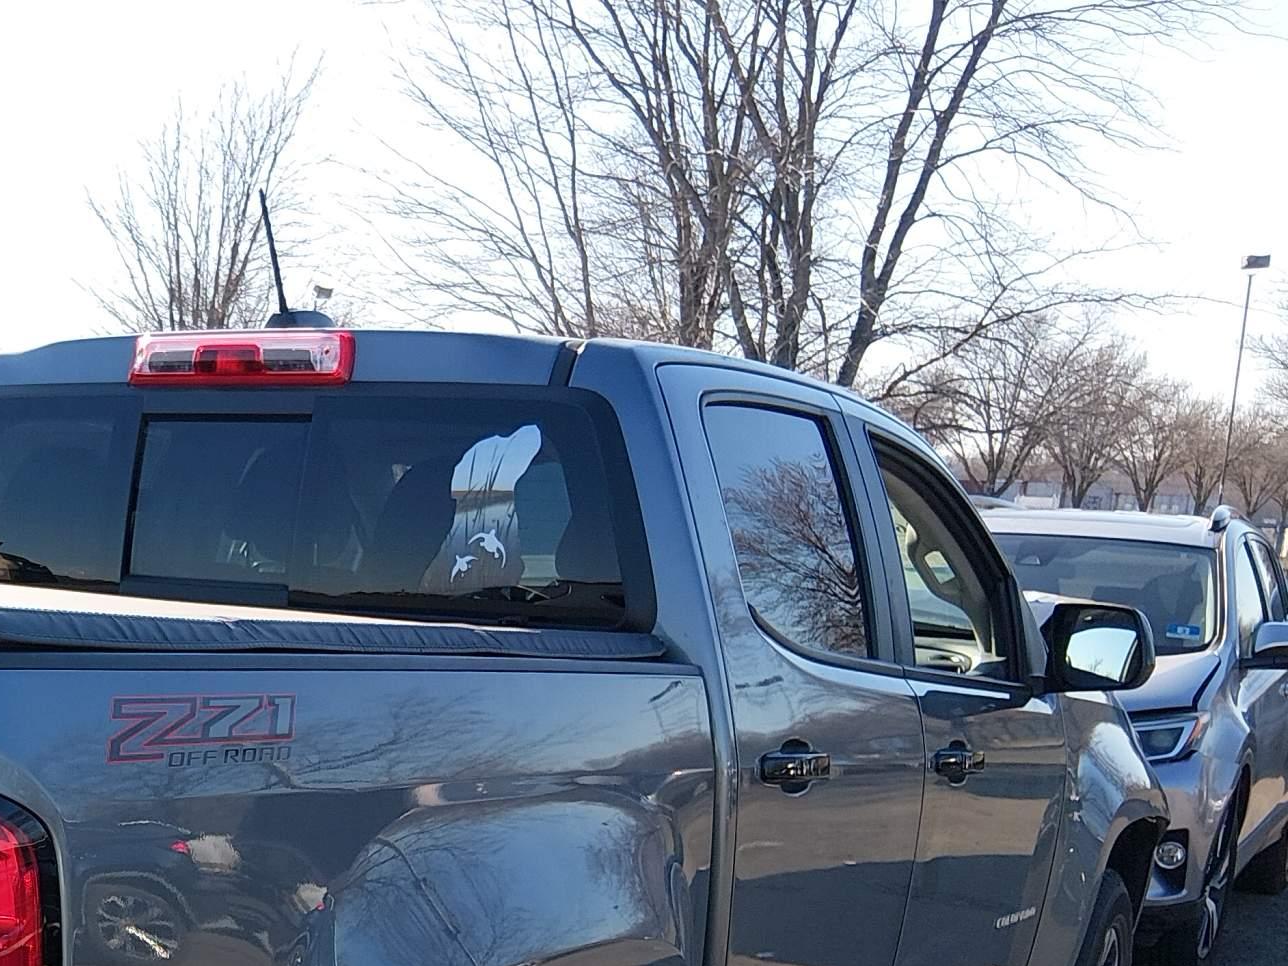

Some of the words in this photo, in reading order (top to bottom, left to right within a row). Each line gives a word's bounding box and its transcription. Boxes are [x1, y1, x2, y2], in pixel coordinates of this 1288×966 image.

[105, 692, 297, 765] Z71
[168, 751, 217, 768] OFF
[223, 746, 292, 765] ROAD
